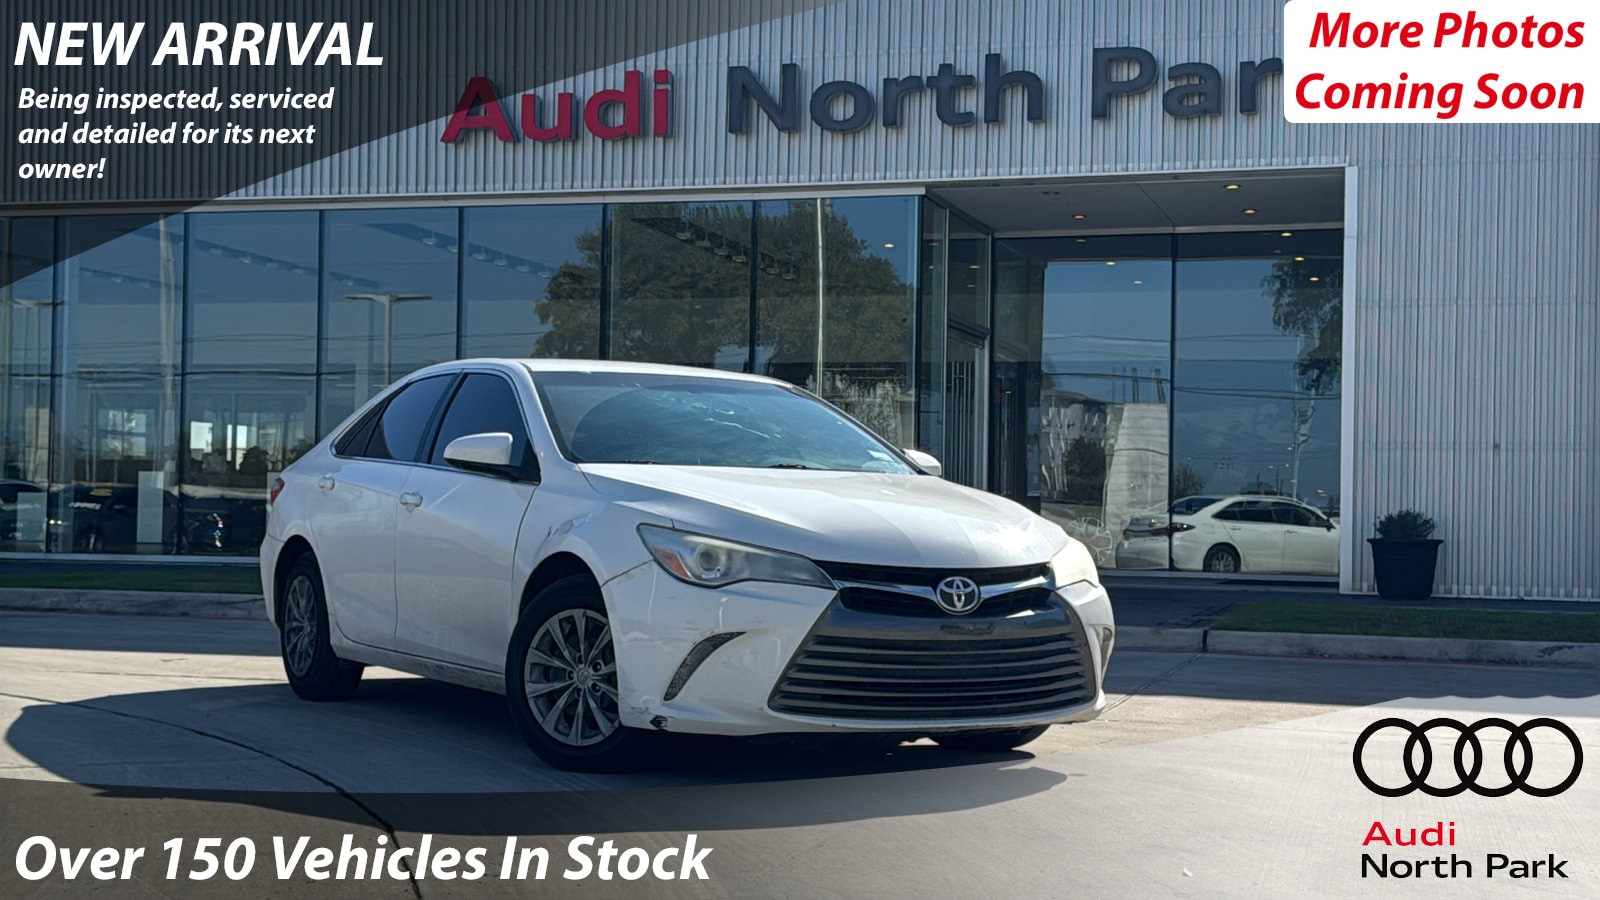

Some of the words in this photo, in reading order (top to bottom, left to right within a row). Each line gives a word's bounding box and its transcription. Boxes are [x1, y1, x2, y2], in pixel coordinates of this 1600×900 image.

[440, 69, 674, 143] Audi
[728, 53, 1044, 135] North
[1092, 46, 1284, 120] Par
